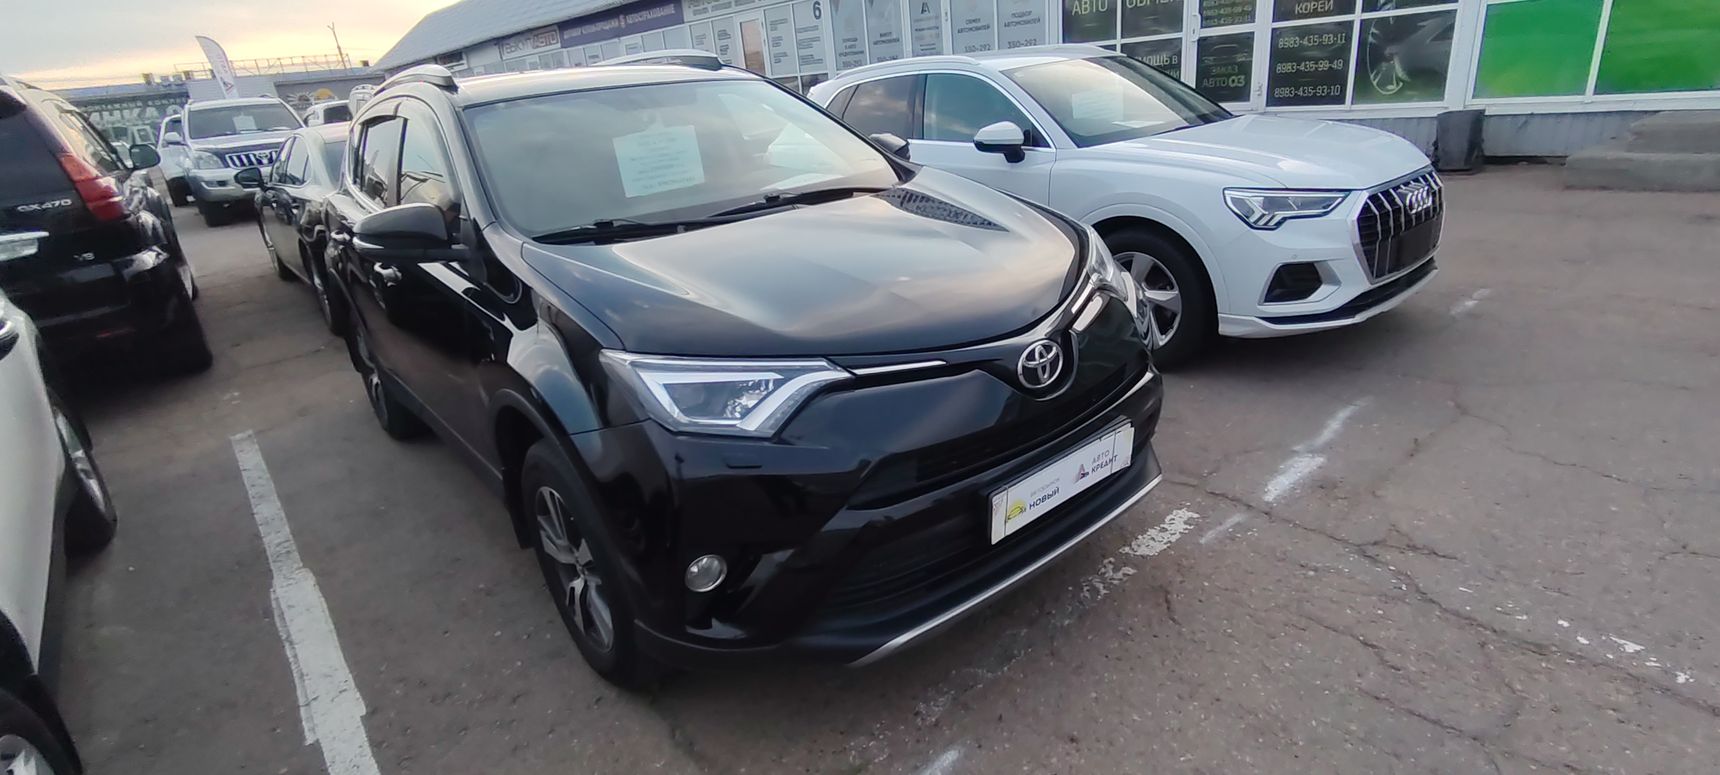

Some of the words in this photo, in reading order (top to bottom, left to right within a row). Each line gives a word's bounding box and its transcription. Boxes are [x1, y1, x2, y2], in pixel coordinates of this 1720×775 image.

[812, 1, 822, 20] 6
[1091, 455, 1118, 474] КРЕДИТ
[1029, 487, 1060, 511] НОВЫЙ
